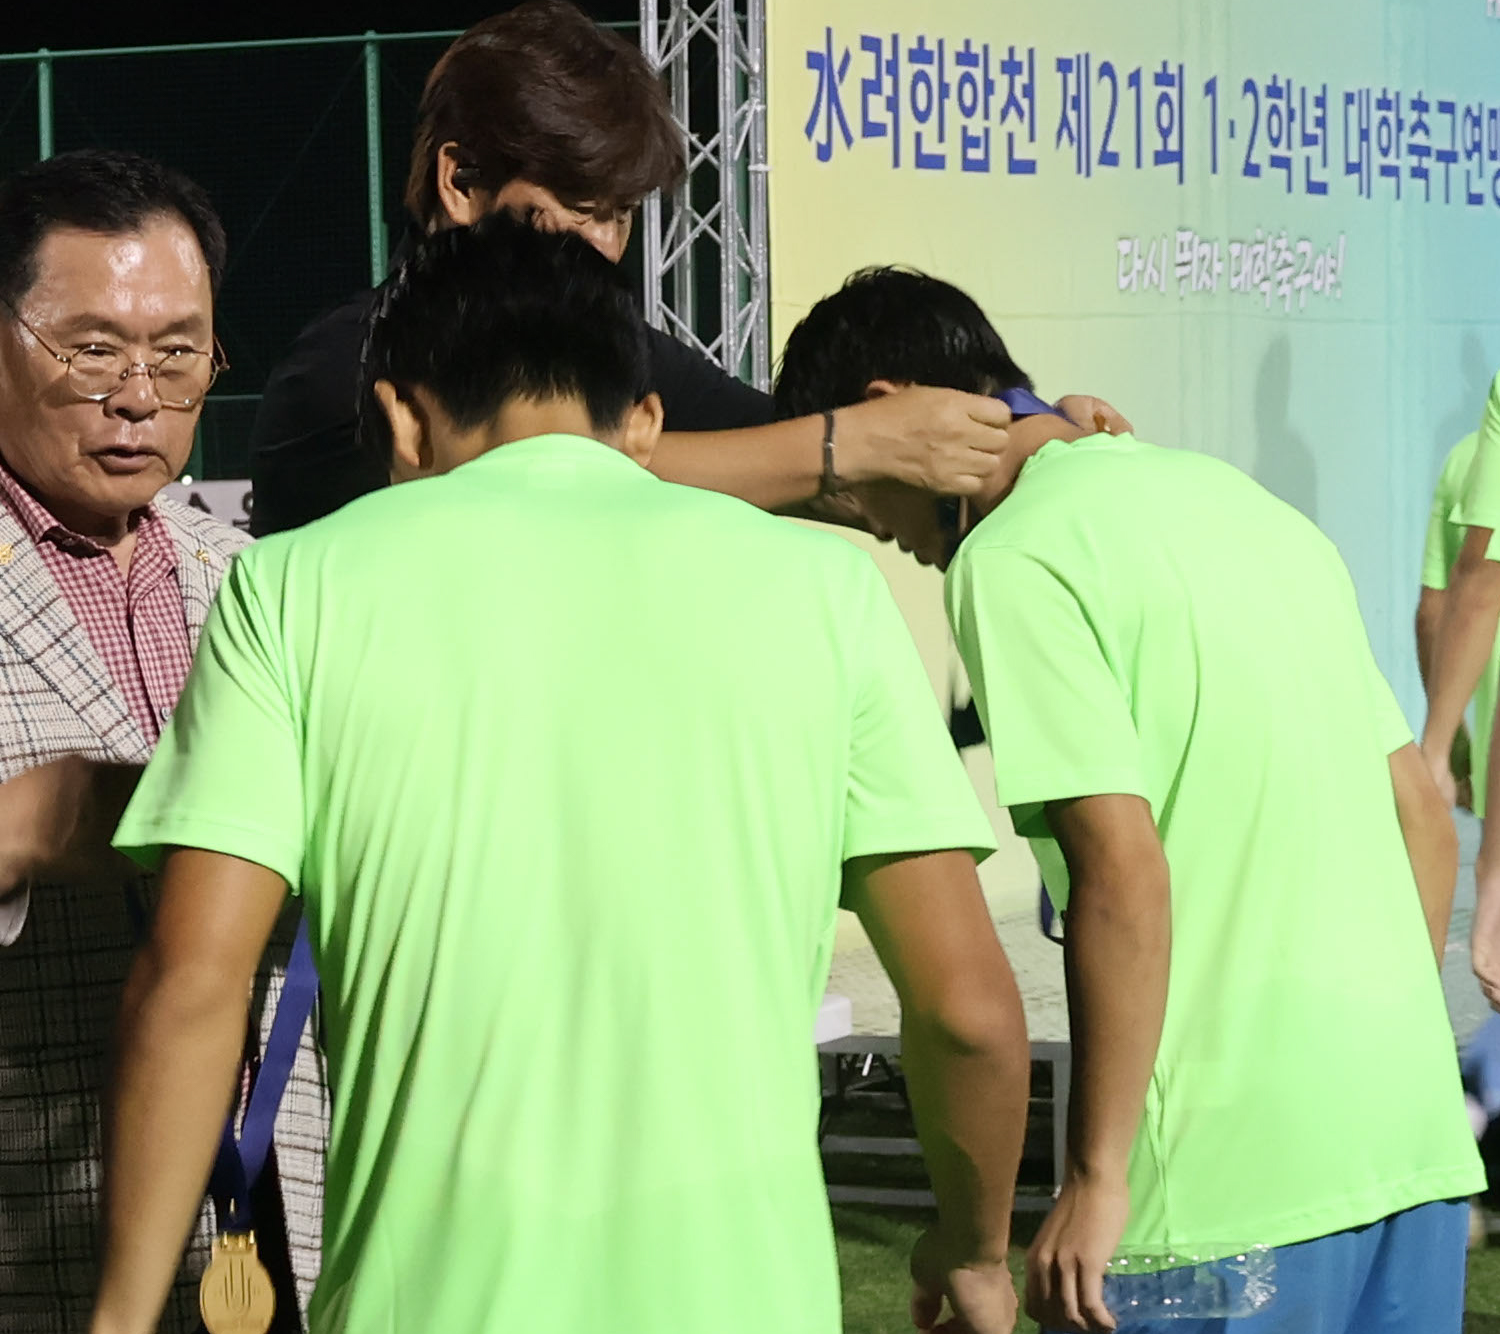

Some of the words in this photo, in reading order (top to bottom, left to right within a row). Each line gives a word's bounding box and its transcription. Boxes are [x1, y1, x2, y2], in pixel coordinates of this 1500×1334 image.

[804, 25, 1038, 175] 水려한합천
[1055, 51, 1185, 185] 제21회
[1203, 73, 1329, 195] 1·2학년
[1117, 237, 1168, 293] 다시
[1175, 228, 1223, 298] 뛰자
[1228, 225, 1346, 312] 대학축구야!
